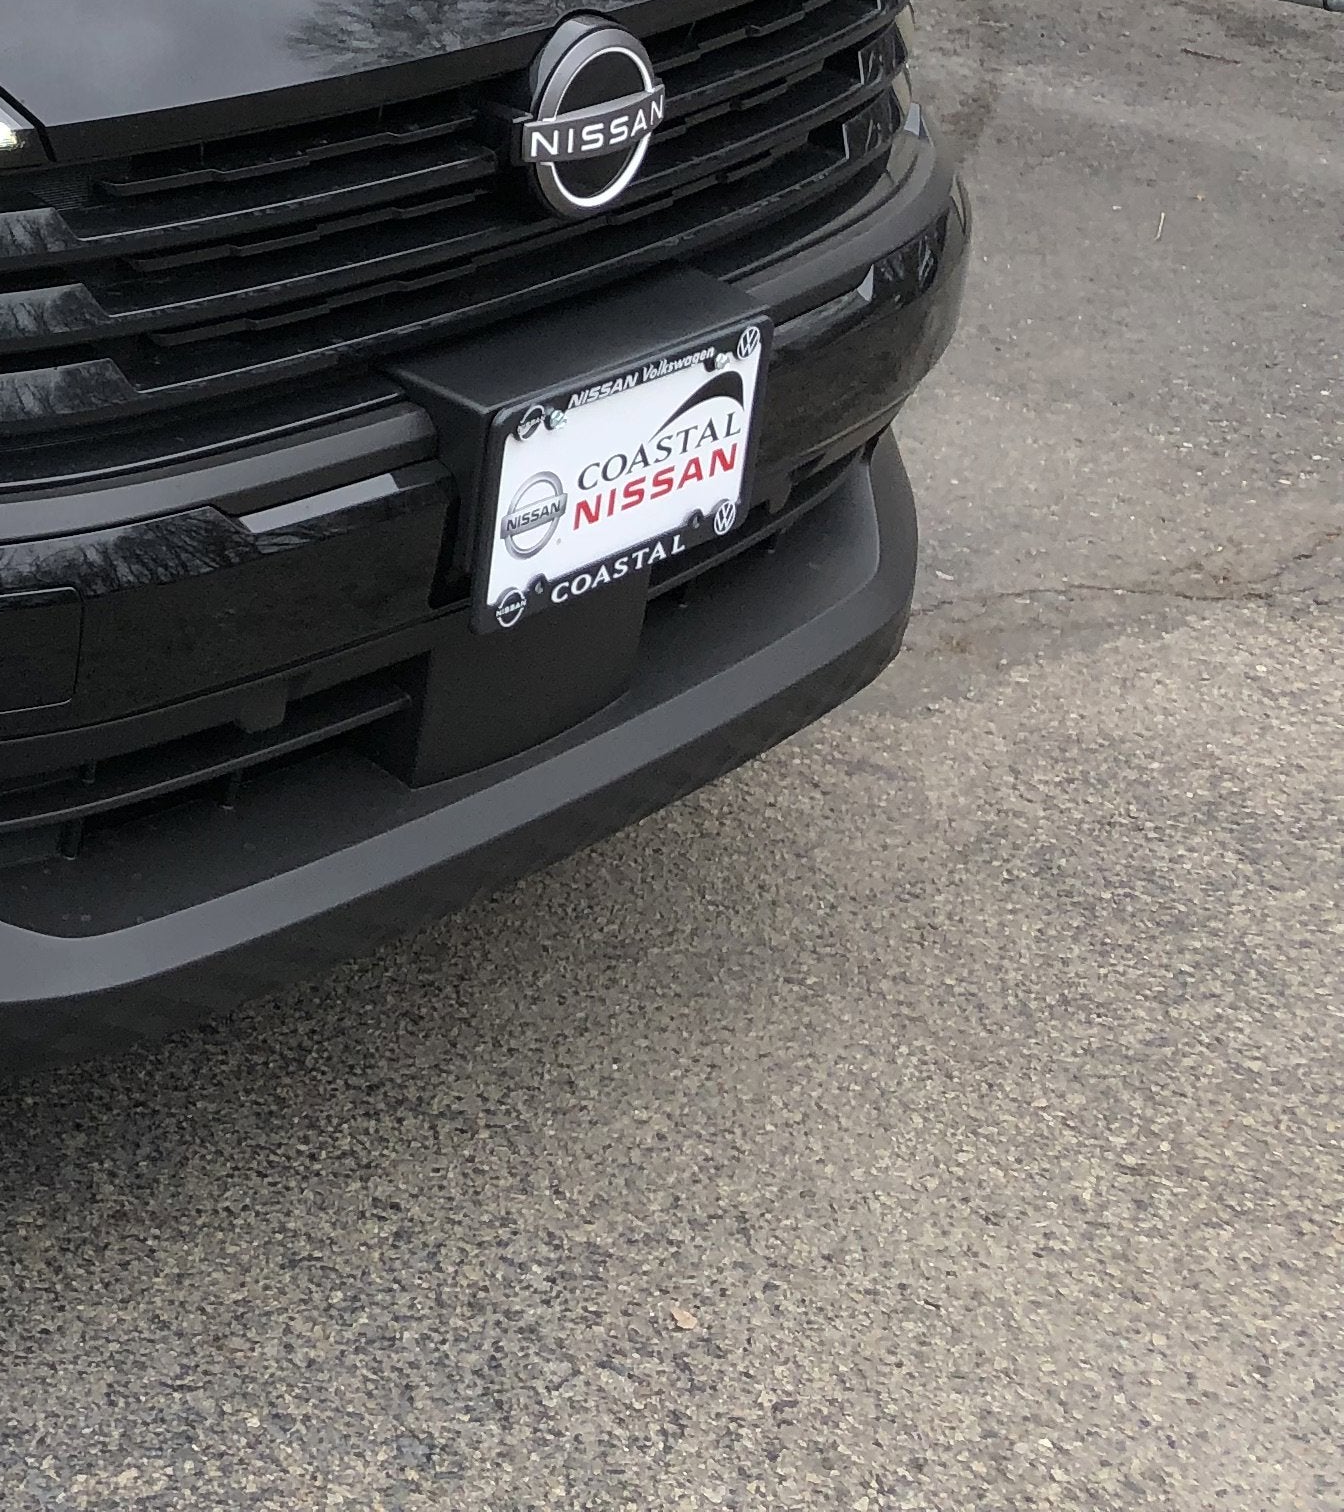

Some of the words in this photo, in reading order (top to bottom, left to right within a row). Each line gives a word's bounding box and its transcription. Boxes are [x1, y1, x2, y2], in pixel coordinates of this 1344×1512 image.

[530, 94, 664, 157] NISSAN
[568, 372, 639, 409] NISSAN
[642, 346, 715, 383] Volkswagen
[577, 411, 742, 491] COASTAL
[506, 500, 561, 531] NISSAN
[572, 443, 738, 531] NISSAN
[550, 535, 686, 604] COASTAL
